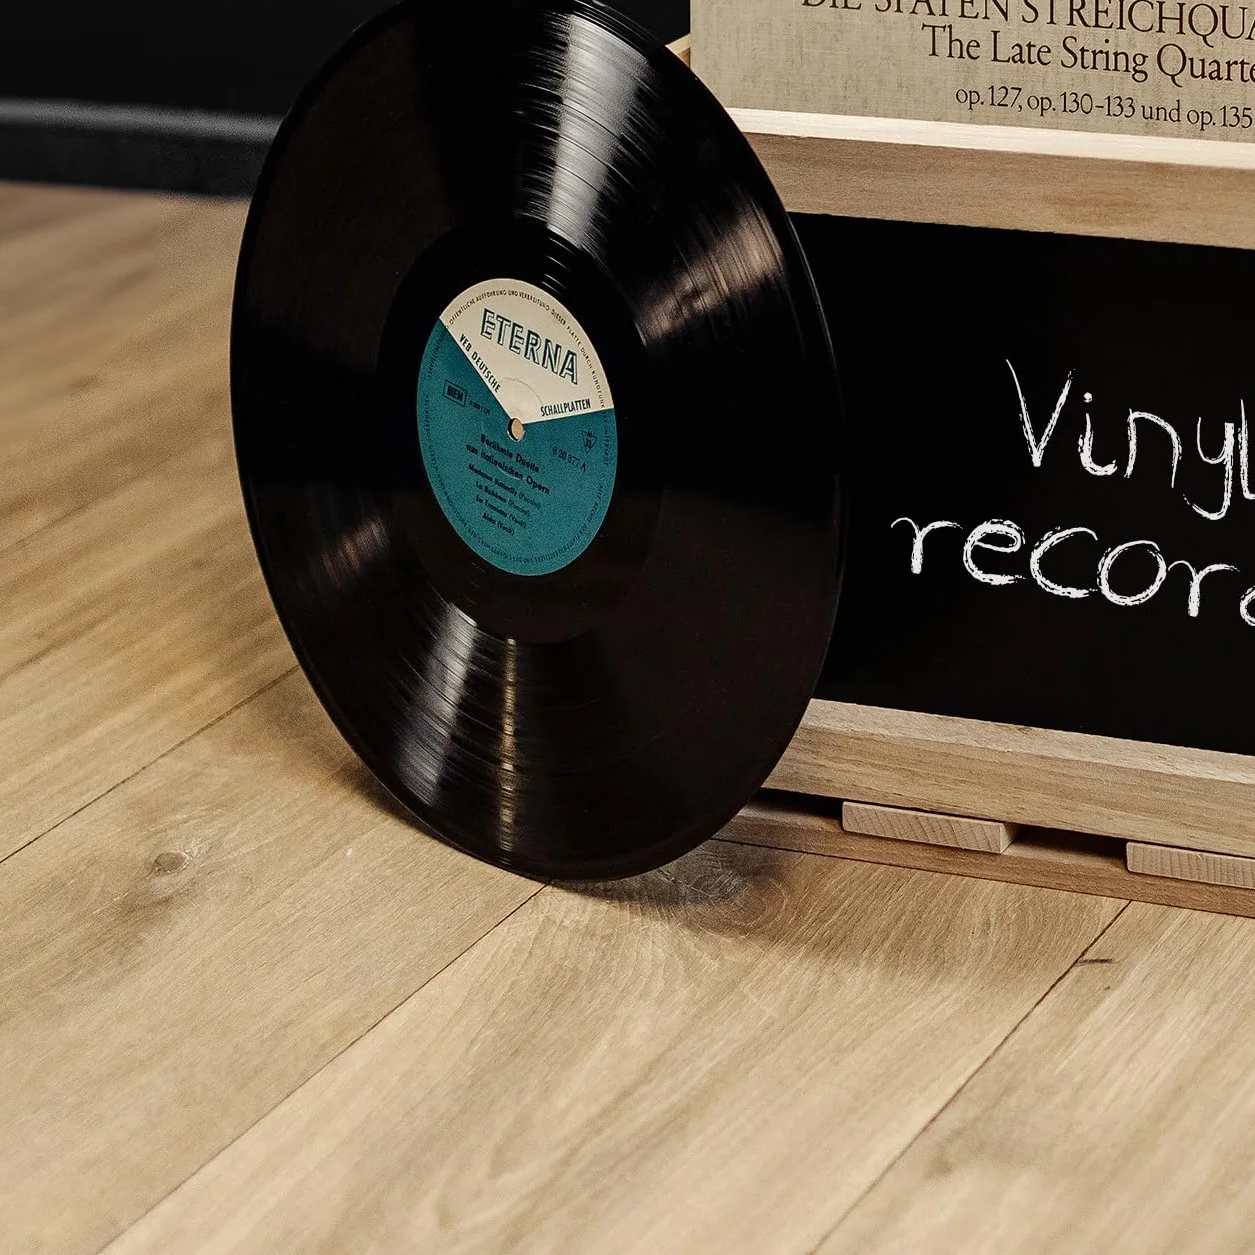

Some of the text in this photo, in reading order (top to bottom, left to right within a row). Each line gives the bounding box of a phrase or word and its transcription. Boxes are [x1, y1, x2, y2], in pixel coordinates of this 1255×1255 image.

[921, 22, 981, 60] The
[990, 30, 1052, 66] Late
[1060, 35, 1149, 83] String
[1141, 99, 1181, 124] und
[459, 333, 472, 352] VEB
[471, 351, 501, 393] DEUTSCHE
[480, 308, 578, 385] ETERNA
[566, 326, 582, 346] PLATTE
[580, 347, 593, 369] DURCH
[591, 370, 606, 408] RUNDFUNK
[540, 398, 591, 417] SCHALLPLATTEN
[526, 475, 550, 494] Opern
